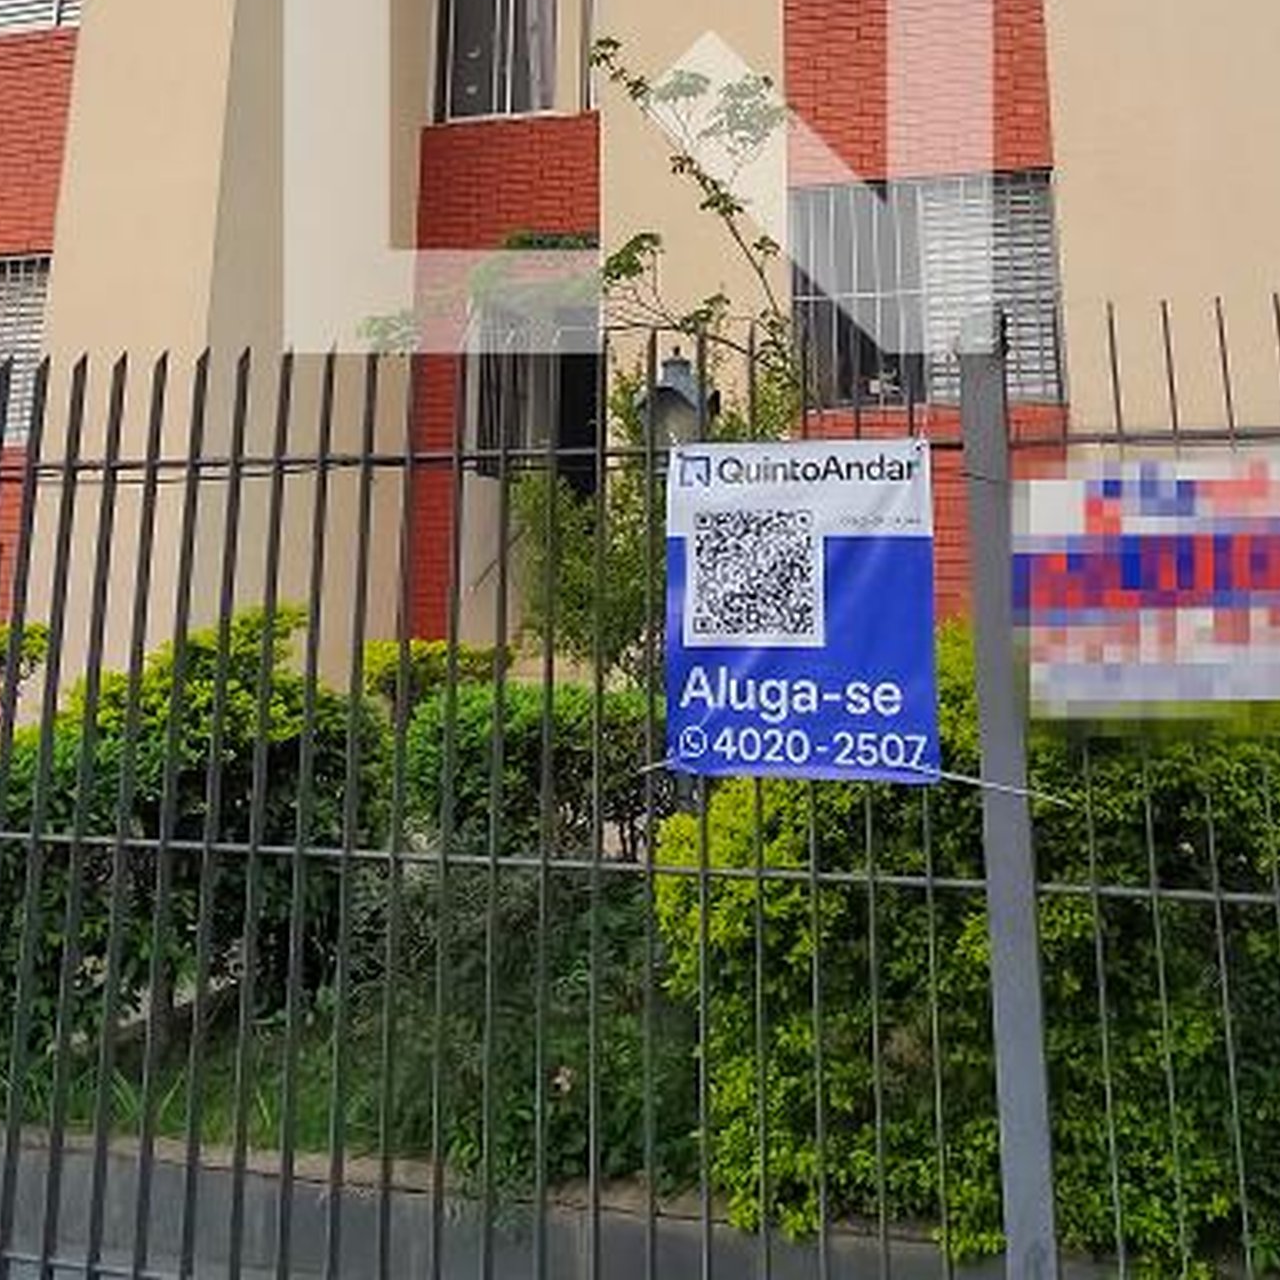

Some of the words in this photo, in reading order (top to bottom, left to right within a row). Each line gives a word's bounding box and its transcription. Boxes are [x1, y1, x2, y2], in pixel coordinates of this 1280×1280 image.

[718, 455, 917, 483] QuintoAndar
[679, 666, 903, 723] Aluga-se
[713, 726, 927, 768] 4020-2507
